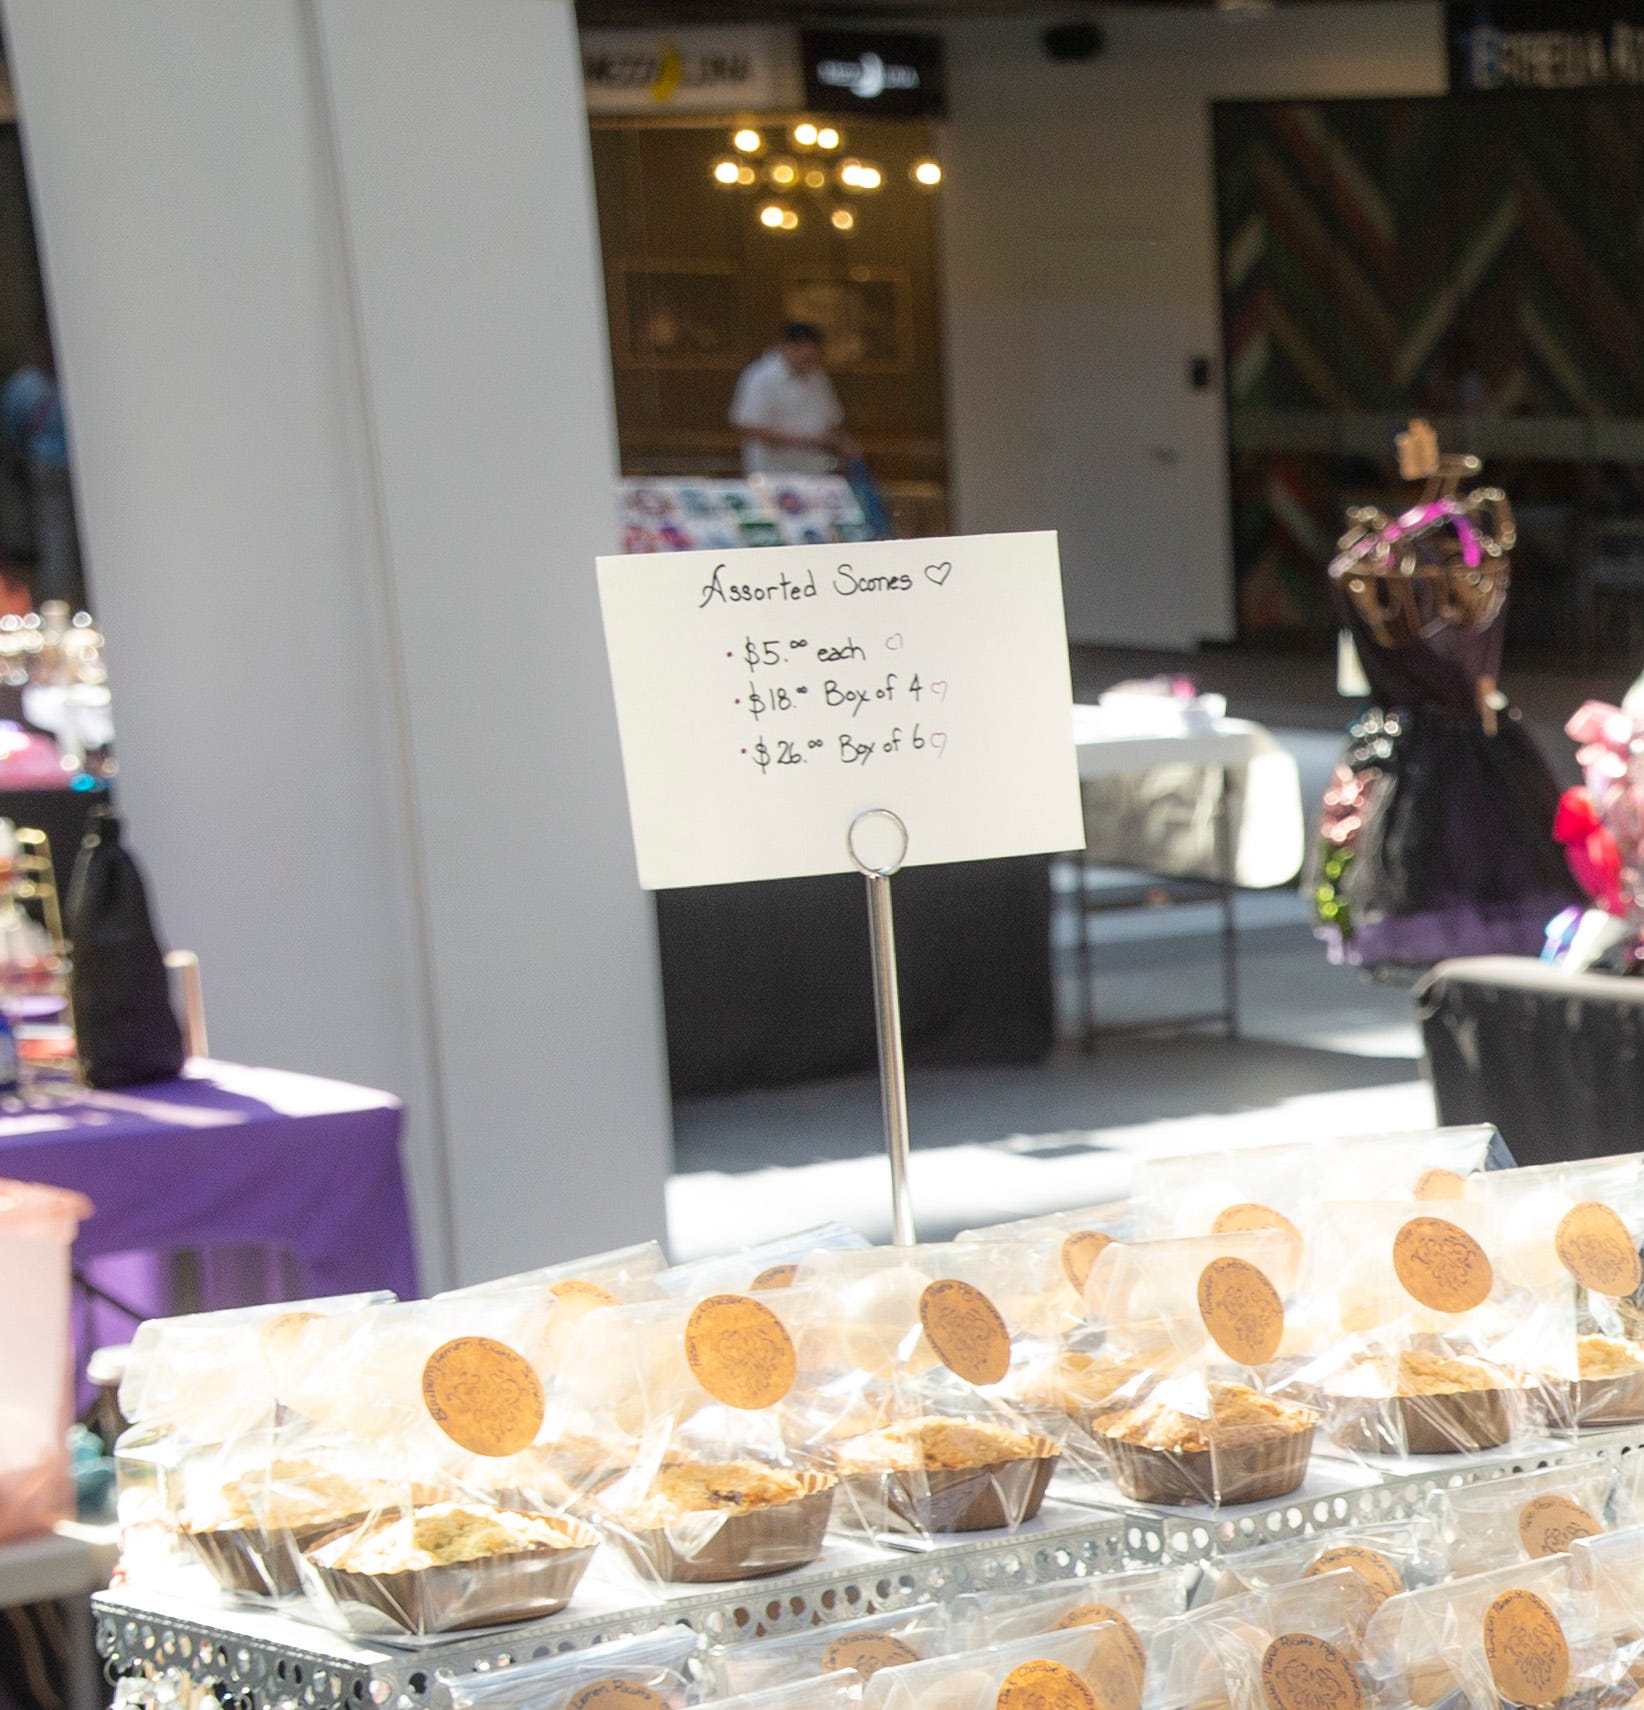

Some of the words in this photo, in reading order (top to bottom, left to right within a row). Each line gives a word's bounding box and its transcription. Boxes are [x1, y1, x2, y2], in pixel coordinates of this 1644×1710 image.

[699, 565, 817, 607] Assorted
[833, 564, 913, 595] Scones
[816, 644, 866, 663] each
[824, 680, 870, 717] Box
[875, 674, 898, 700] of
[908, 674, 923, 701] 4
[839, 734, 875, 766] Box
[883, 729, 901, 753] of
[911, 723, 926, 750] 6
